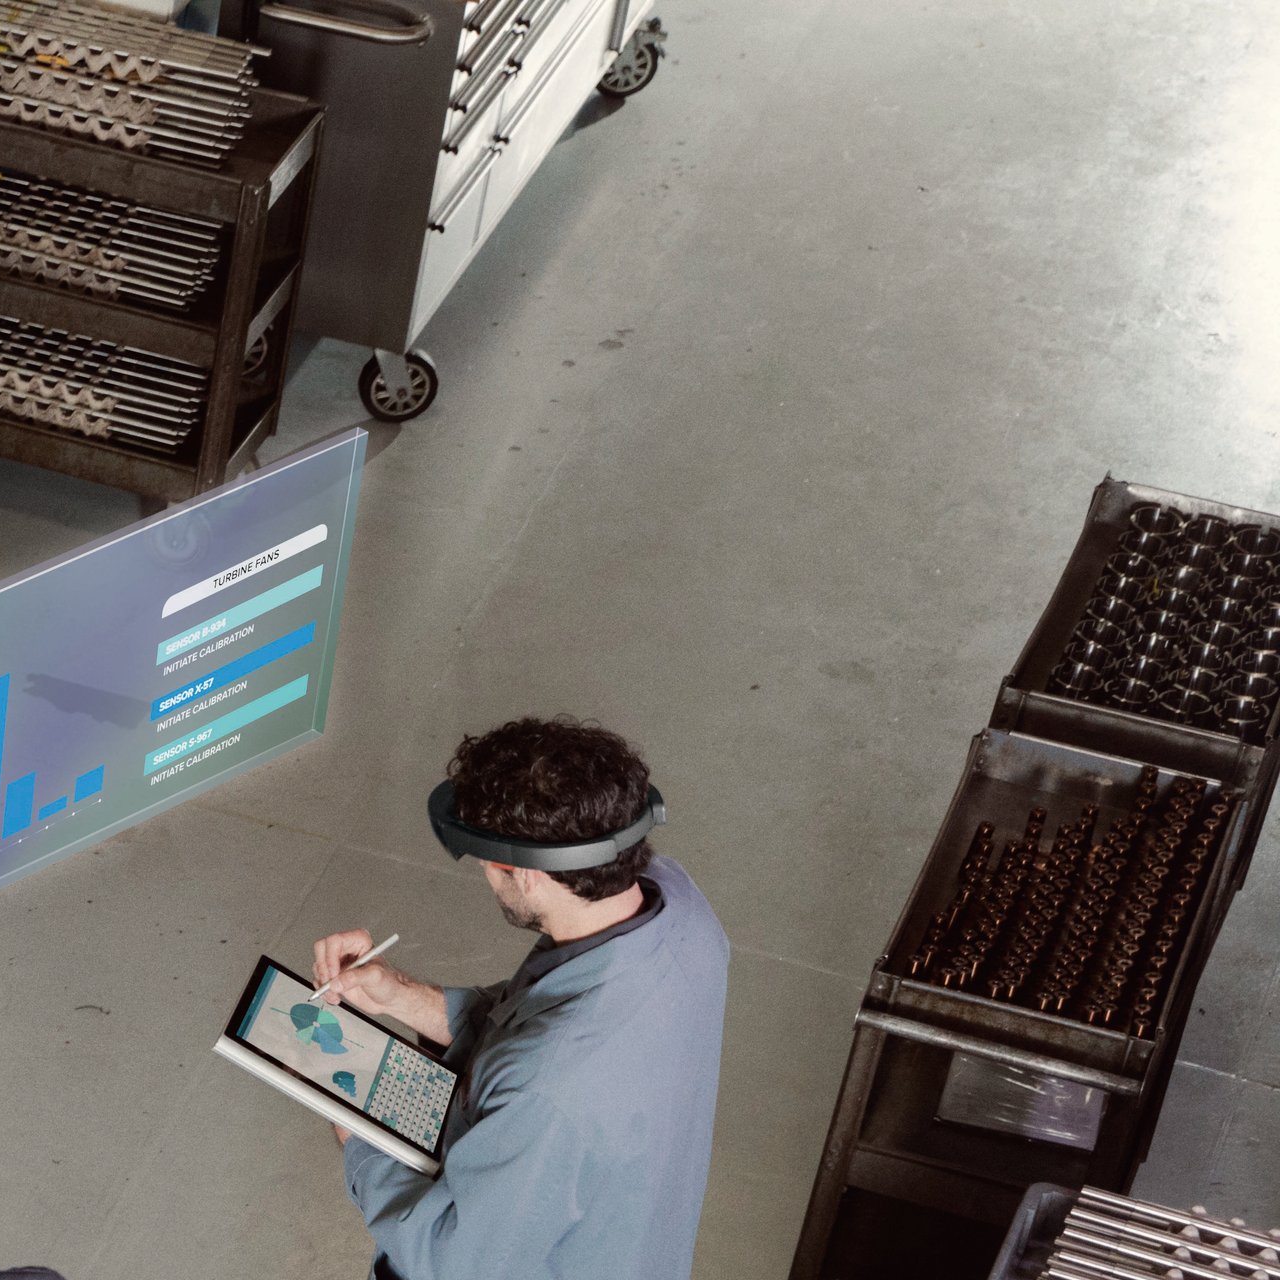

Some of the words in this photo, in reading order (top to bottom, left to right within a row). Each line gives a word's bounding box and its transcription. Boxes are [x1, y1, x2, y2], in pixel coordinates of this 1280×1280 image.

[213, 561, 253, 589] TURBINE
[255, 549, 280, 569] FANS
[163, 653, 198, 677] INITIATE
[199, 624, 255, 658] CALIBRATION
[165, 630, 200, 655] SENSOR
[202, 618, 227, 638] B-934
[156, 709, 191, 733] INITIATE
[192, 680, 248, 715] CALIBRATION
[159, 688, 194, 712] SENSOR
[195, 677, 215, 696] X-57
[150, 762, 185, 787] INITIATE
[186, 733, 241, 768] CALIBRATION
[152, 741, 188, 766] SENSOR
[189, 728, 213, 748] S-967
